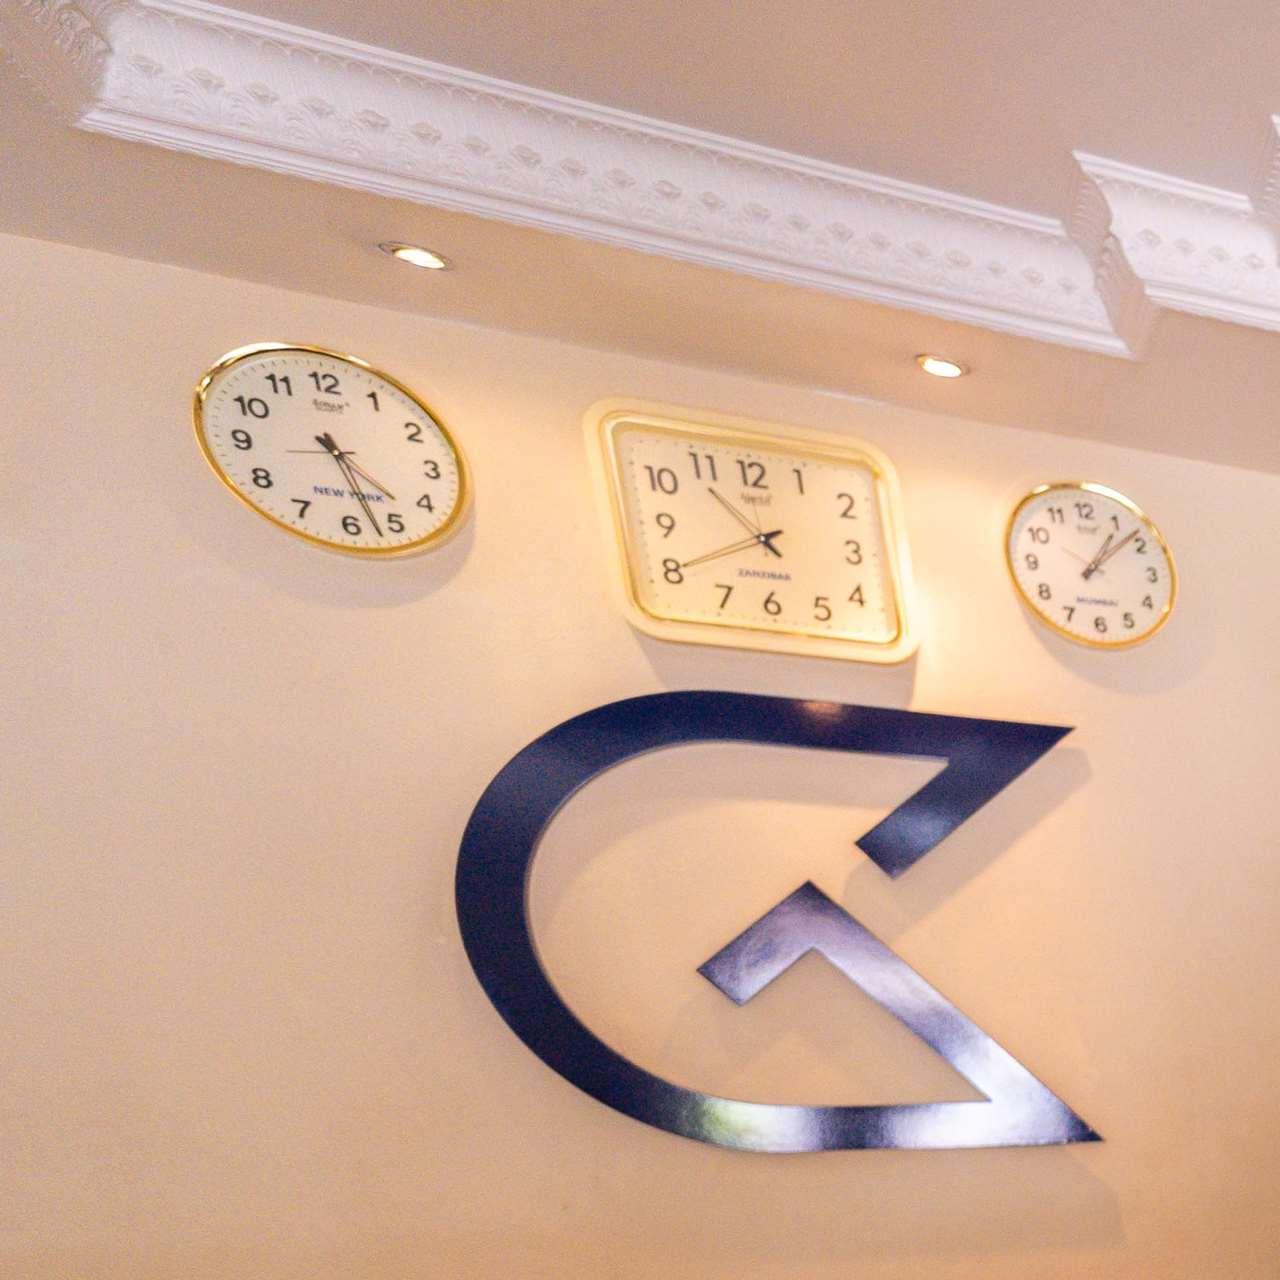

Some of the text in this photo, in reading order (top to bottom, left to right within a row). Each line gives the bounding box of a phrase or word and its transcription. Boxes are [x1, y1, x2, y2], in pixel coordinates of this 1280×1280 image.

[265, 373, 293, 397] 11
[308, 371, 342, 396] 12
[234, 396, 270, 419] 10
[367, 391, 380, 412] 1
[231, 429, 252, 450] 9
[404, 422, 424, 443] 2
[423, 460, 441, 480] 3
[689, 451, 717, 482] 11
[736, 459, 769, 489] 12
[252, 467, 274, 489] 8
[644, 465, 678, 495] 10
[792, 468, 805, 495] 1
[313, 485, 344, 498] NEW
[290, 498, 311, 518] 7
[416, 493, 434, 513] 4
[836, 493, 856, 519] 2
[1074, 502, 1094, 520] 12
[342, 515, 362, 536] 6
[387, 514, 405, 533] 5
[656, 512, 676, 538] 9
[1048, 507, 1065, 524] 11
[1111, 515, 1120, 531] 1
[1027, 526, 1050, 545] 10
[1134, 537, 1147, 554] 2
[844, 540, 863, 565] 3
[1025, 553, 1039, 570] 9
[662, 557, 684, 584] 8
[1146, 566, 1158, 583] 3
[715, 584, 734, 609] 7
[848, 584, 867, 607] 4
[1038, 583, 1052, 600] 8
[763, 591, 783, 616] 6
[814, 596, 832, 622] 5
[1141, 595, 1153, 610] 4
[1063, 605, 1076, 622] 7
[1122, 612, 1135, 629] 5
[1094, 616, 1108, 633] 6
